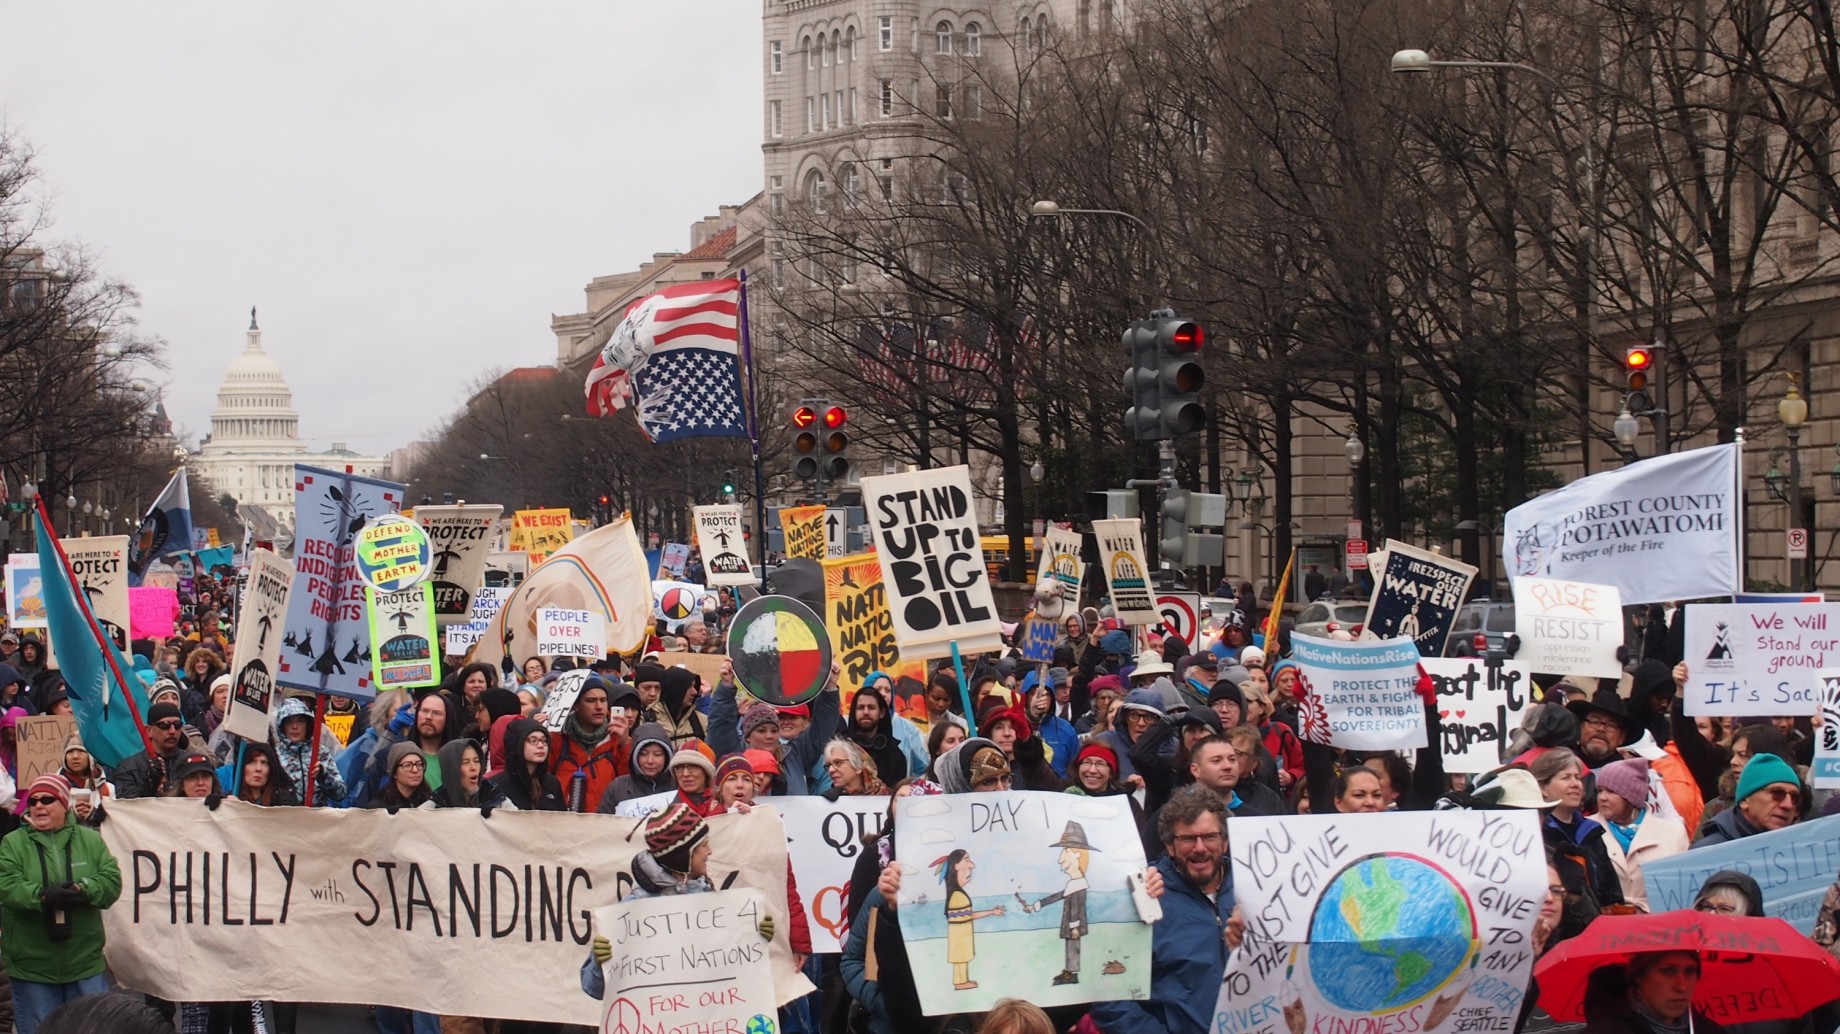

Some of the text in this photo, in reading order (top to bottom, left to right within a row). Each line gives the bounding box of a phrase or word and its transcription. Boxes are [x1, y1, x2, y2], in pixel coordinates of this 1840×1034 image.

[878, 484, 968, 529] STAND
[1563, 494, 1726, 529] FOREST COUNTY
[521, 515, 566, 527] WE EXIST
[702, 516, 736, 526] PROTECT
[788, 515, 823, 544] NATIVE
[1562, 513, 1723, 546] POTAWATOMI
[366, 525, 410, 540] DEFEND
[422, 526, 488, 540] PROTECT
[790, 530, 824, 556] NATIONS
[882, 522, 940, 560] UP
[944, 527, 975, 551] TO
[374, 544, 417, 560] MOTHER
[828, 546, 842, 556] HIS
[1104, 537, 1136, 552] WATER
[1561, 540, 1665, 562] Keeper of the Fire
[72, 559, 120, 574] OTECT
[712, 556, 744, 566] WATER
[1116, 564, 1136, 578] LIFE
[376, 564, 416, 581] EARTH
[257, 574, 288, 605] PROTECT
[308, 578, 367, 604] PEOPLES
[376, 592, 424, 606] PROTECT
[436, 589, 464, 602] TER
[476, 588, 496, 598] UGH
[1385, 574, 1457, 610] WATER
[1436, 580, 1460, 596] OUR
[1531, 583, 1598, 610] RISE
[311, 598, 362, 624] RIGHTS
[474, 599, 500, 609] ARCK
[904, 590, 992, 632] OIL
[448, 621, 489, 631] STANDIN
[545, 610, 588, 622] PEOPLE
[1751, 612, 1784, 630] We
[550, 626, 580, 637] OVER
[1534, 618, 1604, 642] RESIST
[386, 638, 428, 652] WATER
[1294, 644, 1415, 665] #NativeNationsRise
[1811, 639, 1838, 651] our
[842, 633, 900, 685] RIS
[1768, 652, 1823, 674] ground
[244, 666, 270, 694] WATER
[386, 671, 400, 680] NO
[1333, 676, 1418, 691] PROTECT THE
[1324, 692, 1419, 704] EARTH & FIGHT
[1705, 681, 1816, 704] It's Sac
[1347, 704, 1419, 716] FOR TRIBAL
[1332, 718, 1420, 732] SOVEREIGNTY
[28, 742, 61, 754] RIGH
[971, 799, 1025, 833] DAY
[1479, 811, 1534, 860] YOU
[1234, 820, 1296, 891] YOU
[1292, 825, 1349, 897] GIVE
[1428, 818, 1512, 884] WOULD
[1791, 837, 1840, 881] LIF
[133, 850, 296, 925] PHILLY
[310, 878, 345, 903] with
[352, 858, 593, 946] STANDING
[1479, 886, 1536, 920] GIVE
[617, 898, 759, 944] JUSTICE 4
[1488, 927, 1523, 946] TO
[620, 954, 671, 979] FIRST
[681, 942, 763, 970] NATIONS
[1482, 950, 1530, 973] ANY
[1223, 942, 1288, 1002] TO THE
[650, 988, 746, 1015] FOR OUR
[1468, 974, 1523, 1016] BROTHER
[1216, 995, 1280, 1034] RIVER
[1312, 1005, 1423, 1034] KINDNESS
[1453, 1016, 1510, 1034] SEATTLE
[642, 1018, 745, 1034] MOTHER
